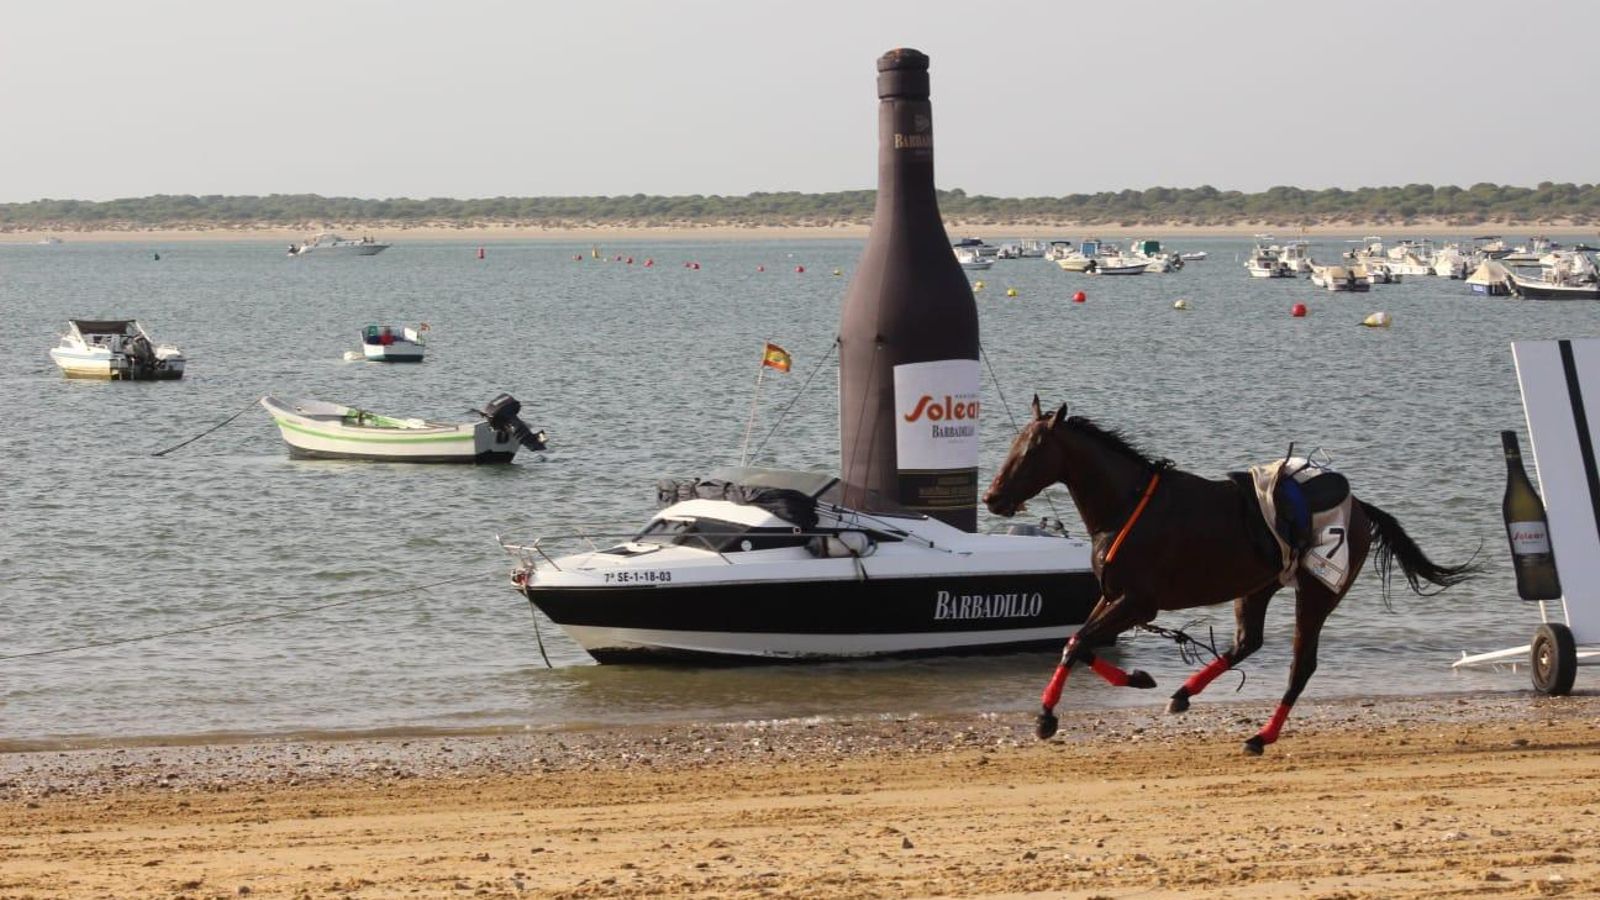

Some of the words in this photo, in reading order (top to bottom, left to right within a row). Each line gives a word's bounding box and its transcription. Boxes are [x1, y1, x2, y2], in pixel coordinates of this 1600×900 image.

[1326, 528, 1345, 559] 7
[617, 571, 672, 582] SE-1-18-03
[934, 590, 1043, 620] BARBADILLO
